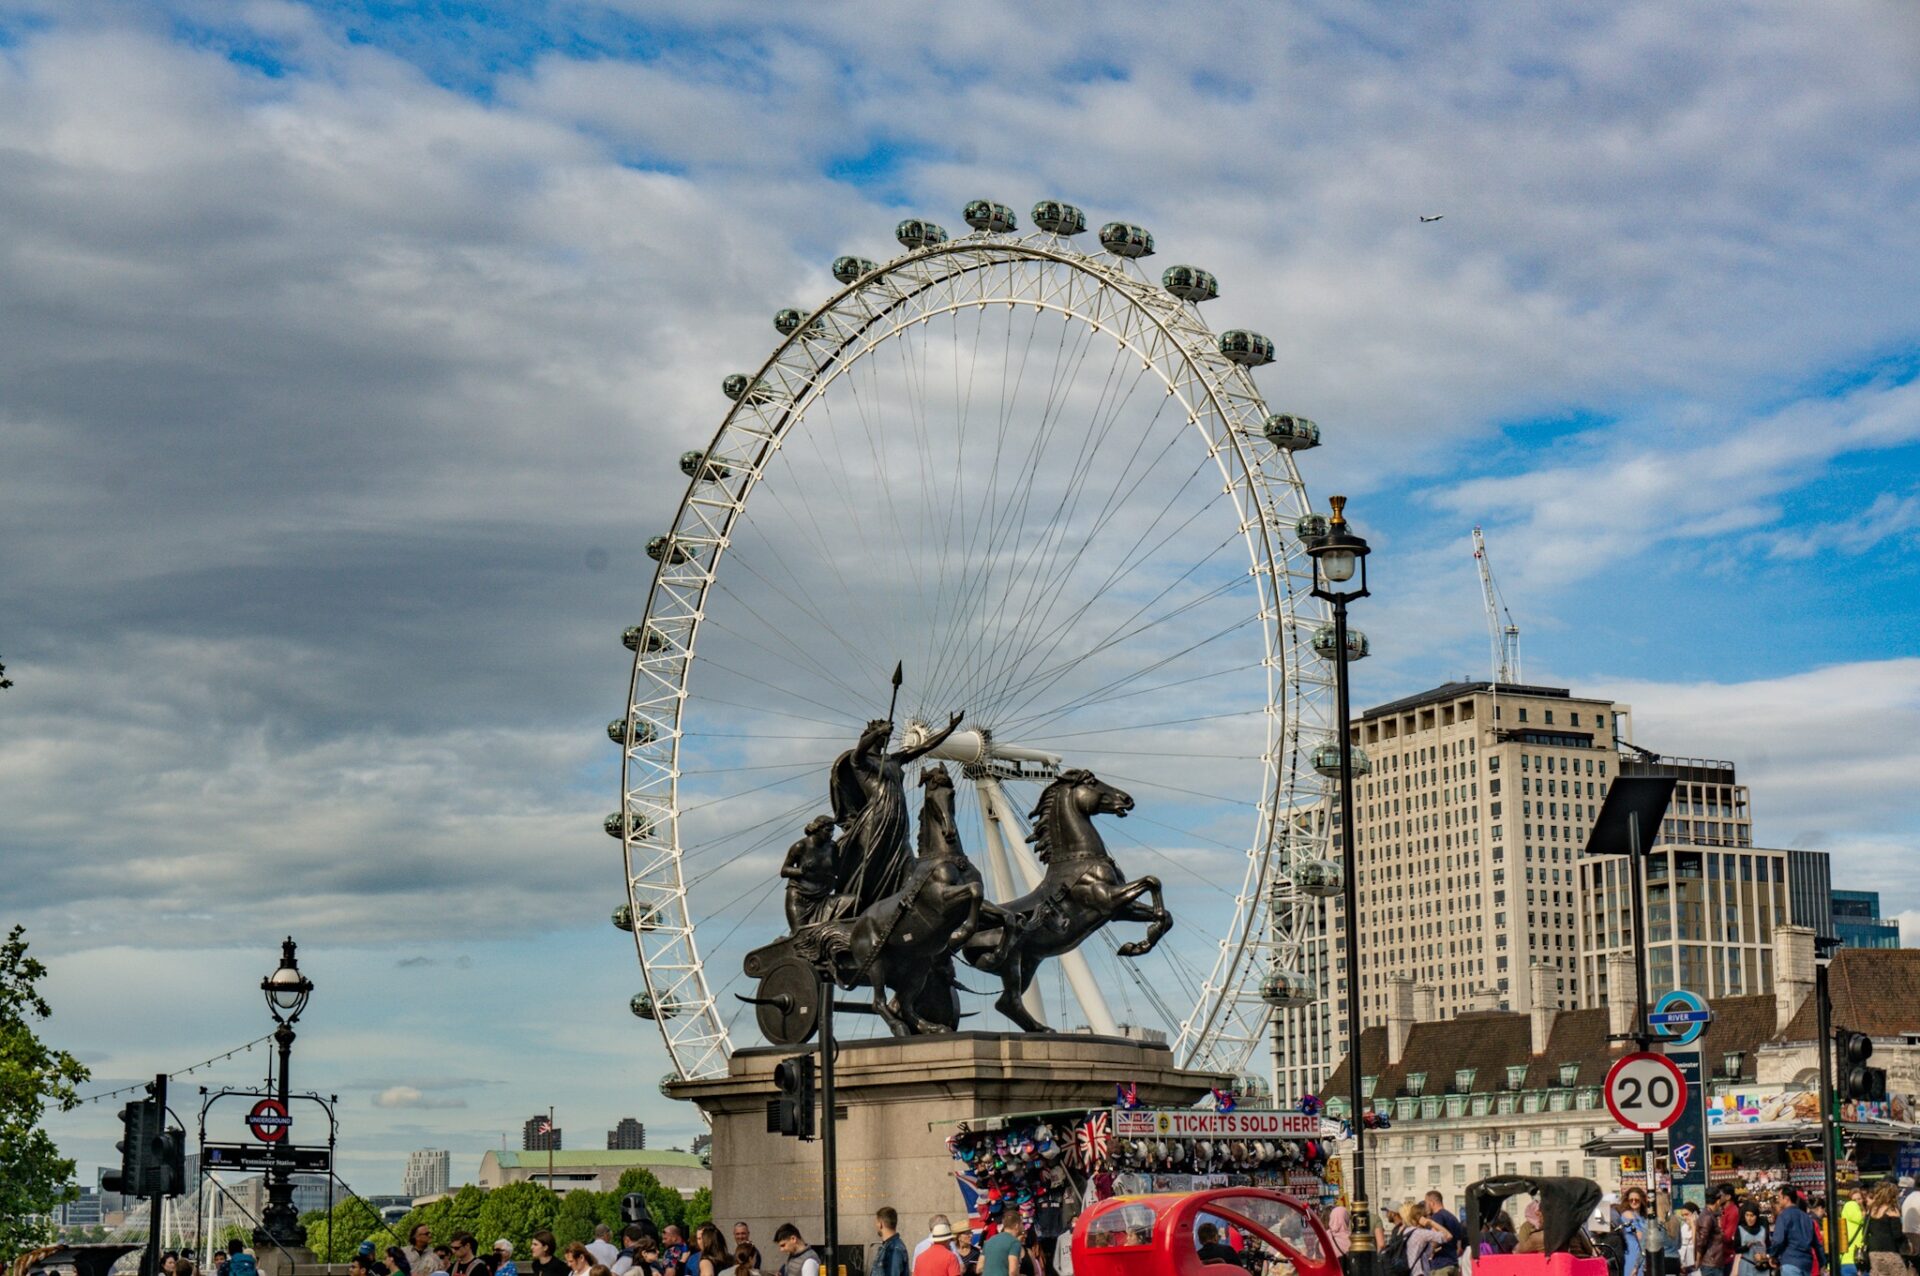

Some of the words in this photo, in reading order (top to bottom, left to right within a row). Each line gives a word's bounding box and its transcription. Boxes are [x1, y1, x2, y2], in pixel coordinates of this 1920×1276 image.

[1667, 1013, 1690, 1022] RIVER
[1618, 1076, 1674, 1109] 20
[249, 1116, 291, 1125] UNDERGROUND
[1173, 1115, 1236, 1132] TICKETS
[1241, 1116, 1278, 1132] SOLD
[1283, 1116, 1318, 1132] HERE
[240, 1158, 275, 1166] Westminster
[1714, 1156, 1729, 1167] £1
[1792, 1152, 1809, 1162] £1
[1624, 1157, 1638, 1169] £1
